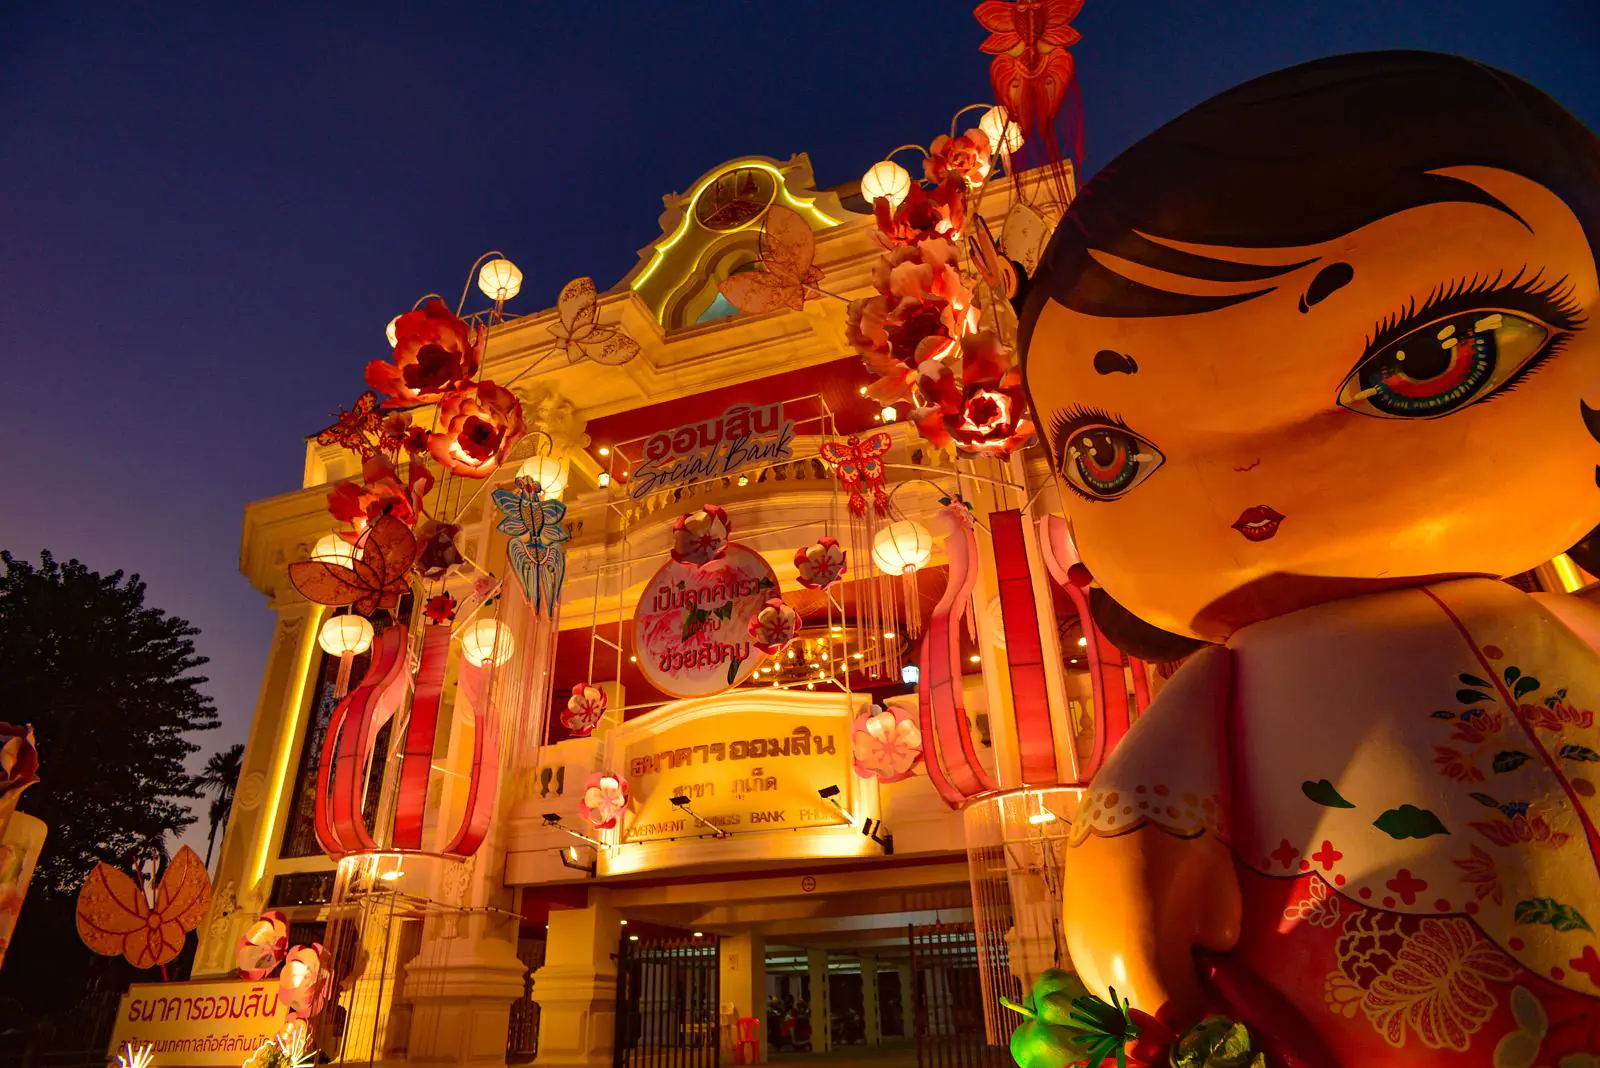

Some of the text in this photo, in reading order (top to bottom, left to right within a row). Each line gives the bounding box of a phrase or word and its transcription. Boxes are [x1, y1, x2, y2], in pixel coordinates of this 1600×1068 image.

[646, 405, 779, 462] ออมสิน
[633, 423, 793, 499] Social Bank
[658, 641, 750, 672] ช่วยสังคม
[630, 725, 836, 778] ธนาคารออมสิน
[731, 767, 778, 801] ภูเก็ต
[751, 810, 786, 824] BANK
[128, 987, 279, 1022] ธนาคารออมสิน
